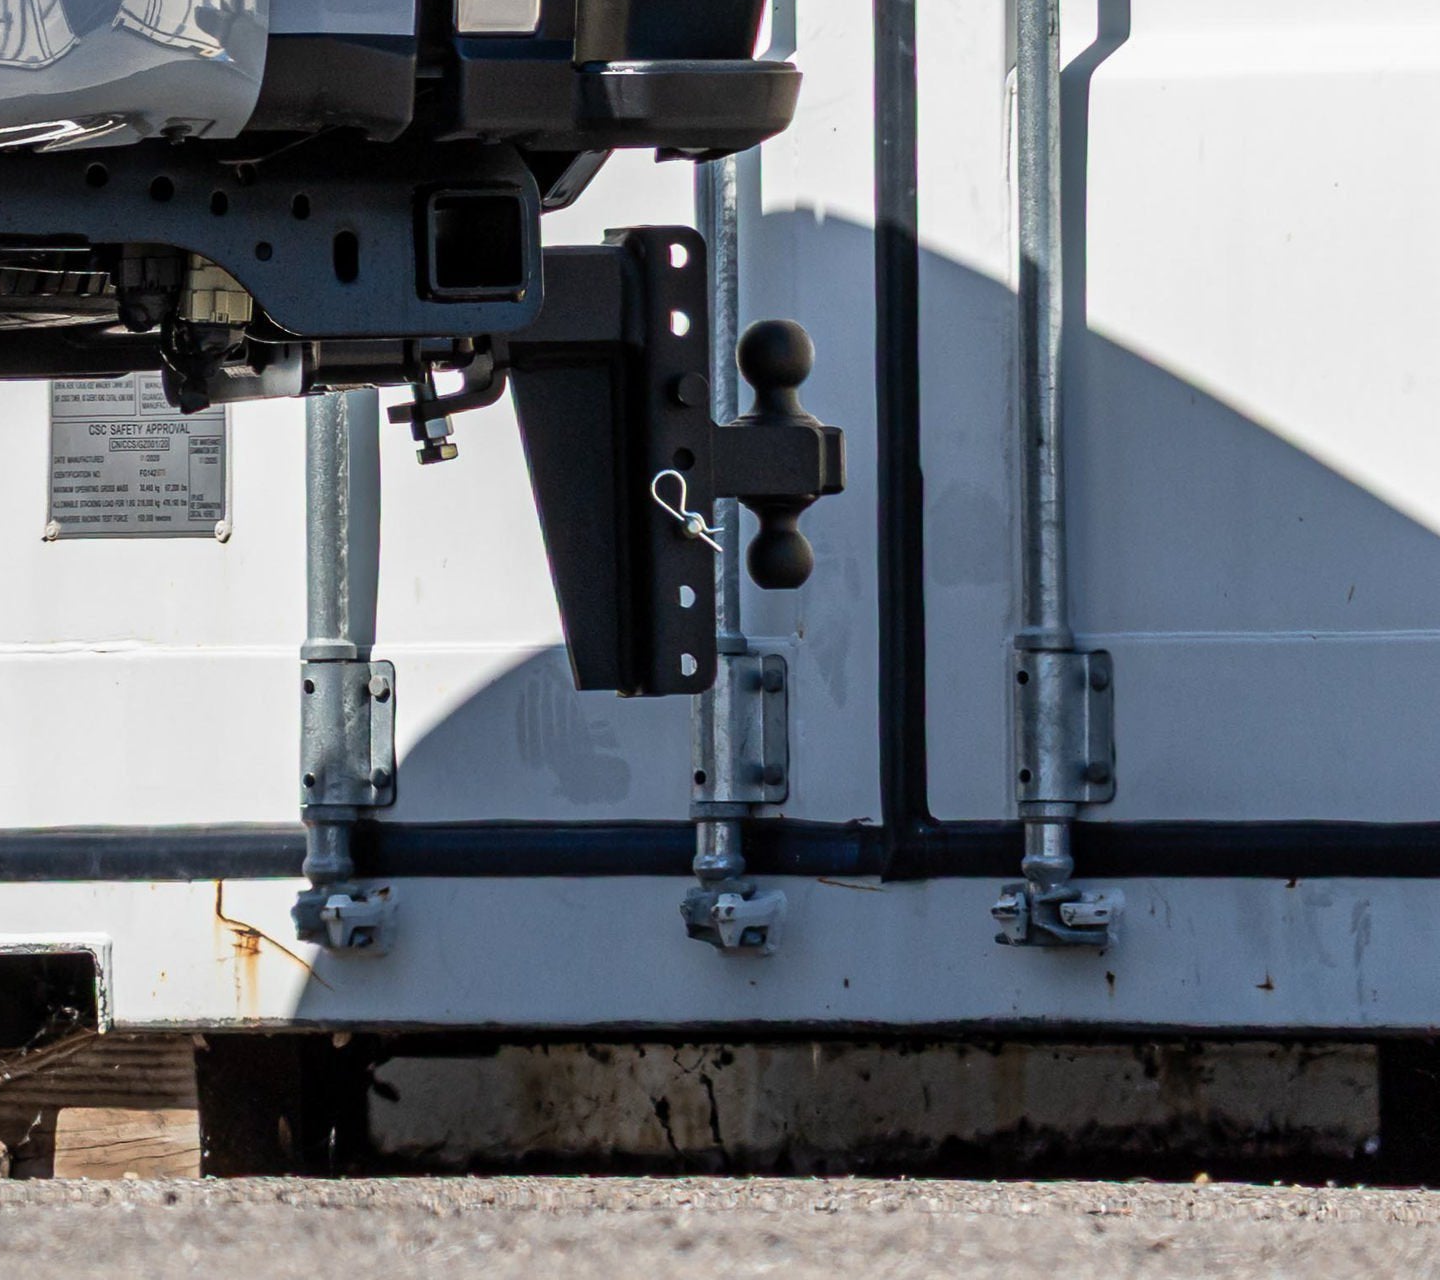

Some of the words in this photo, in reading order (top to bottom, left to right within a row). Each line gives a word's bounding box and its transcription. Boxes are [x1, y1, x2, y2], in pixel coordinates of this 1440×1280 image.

[89, 425, 107, 435] CSC
[111, 424, 143, 435] SAFETY
[146, 423, 190, 434] APPROVAL
